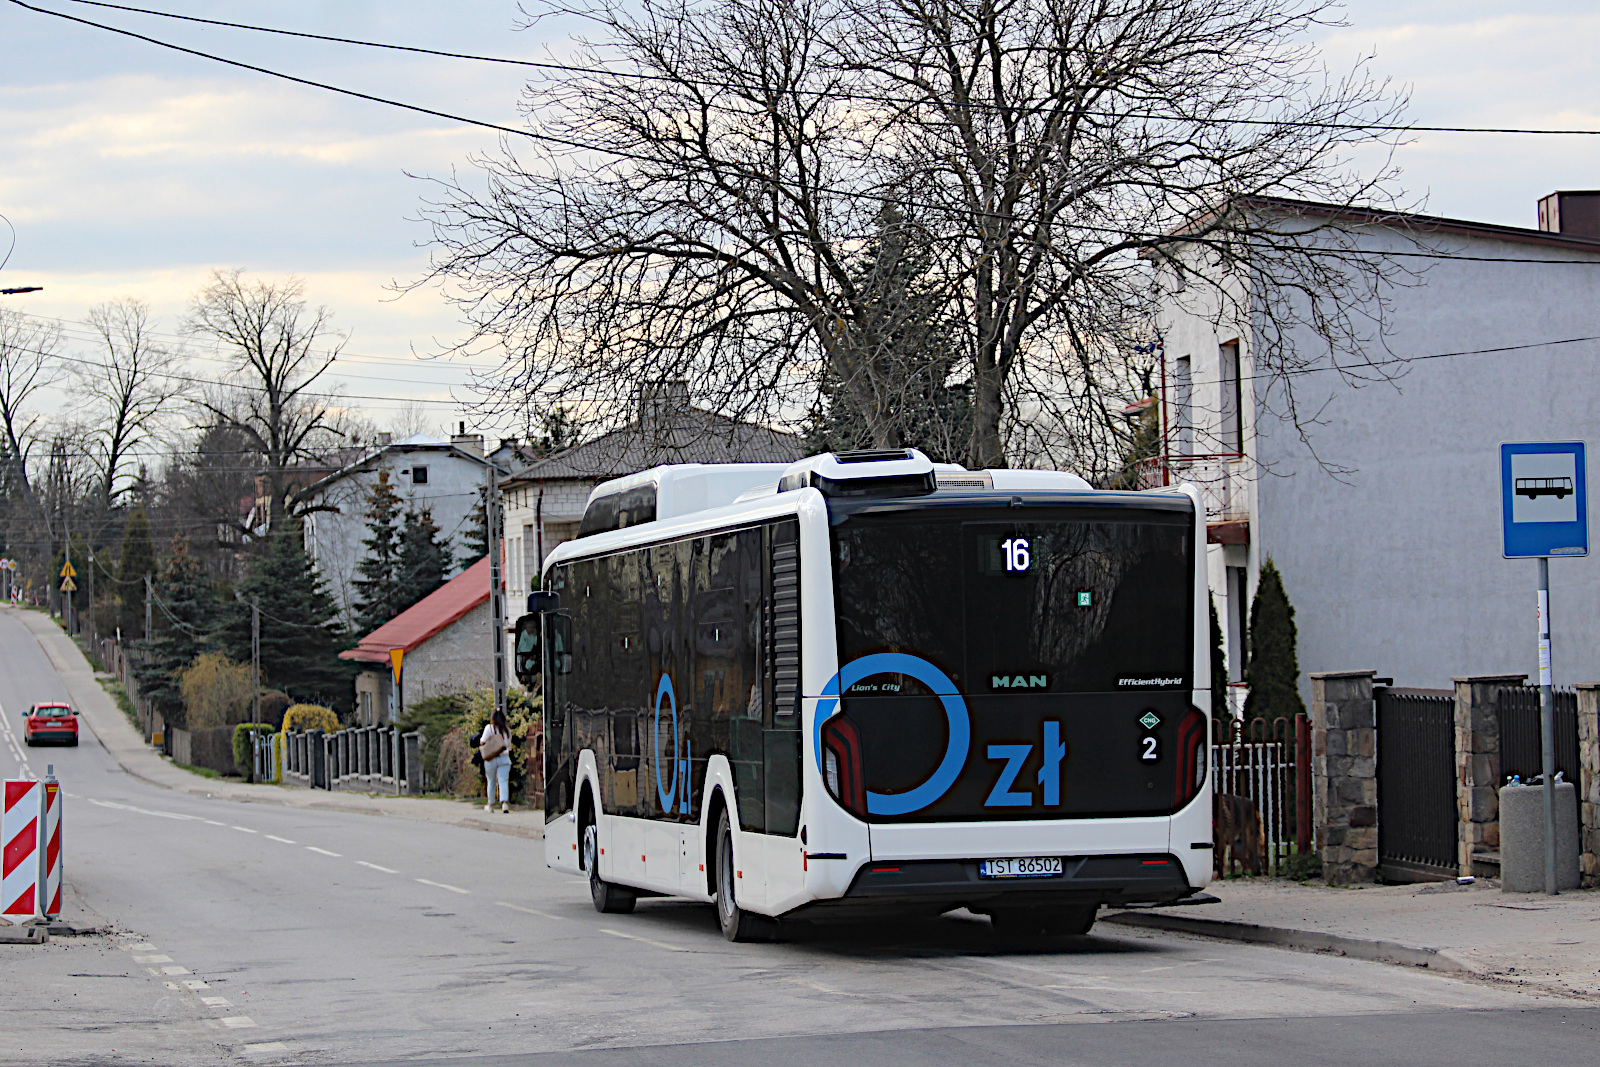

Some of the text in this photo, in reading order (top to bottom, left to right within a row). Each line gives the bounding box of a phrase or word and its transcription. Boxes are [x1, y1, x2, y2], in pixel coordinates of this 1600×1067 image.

[1001, 538, 1030, 571] 16
[851, 683, 901, 692] Lion's City
[992, 675, 1047, 688] MAN
[1118, 678, 1183, 687] EfficientHybrid
[1142, 736, 1157, 759] 2
[984, 721, 1066, 807] zł
[986, 858, 1061, 874] TST 86502
